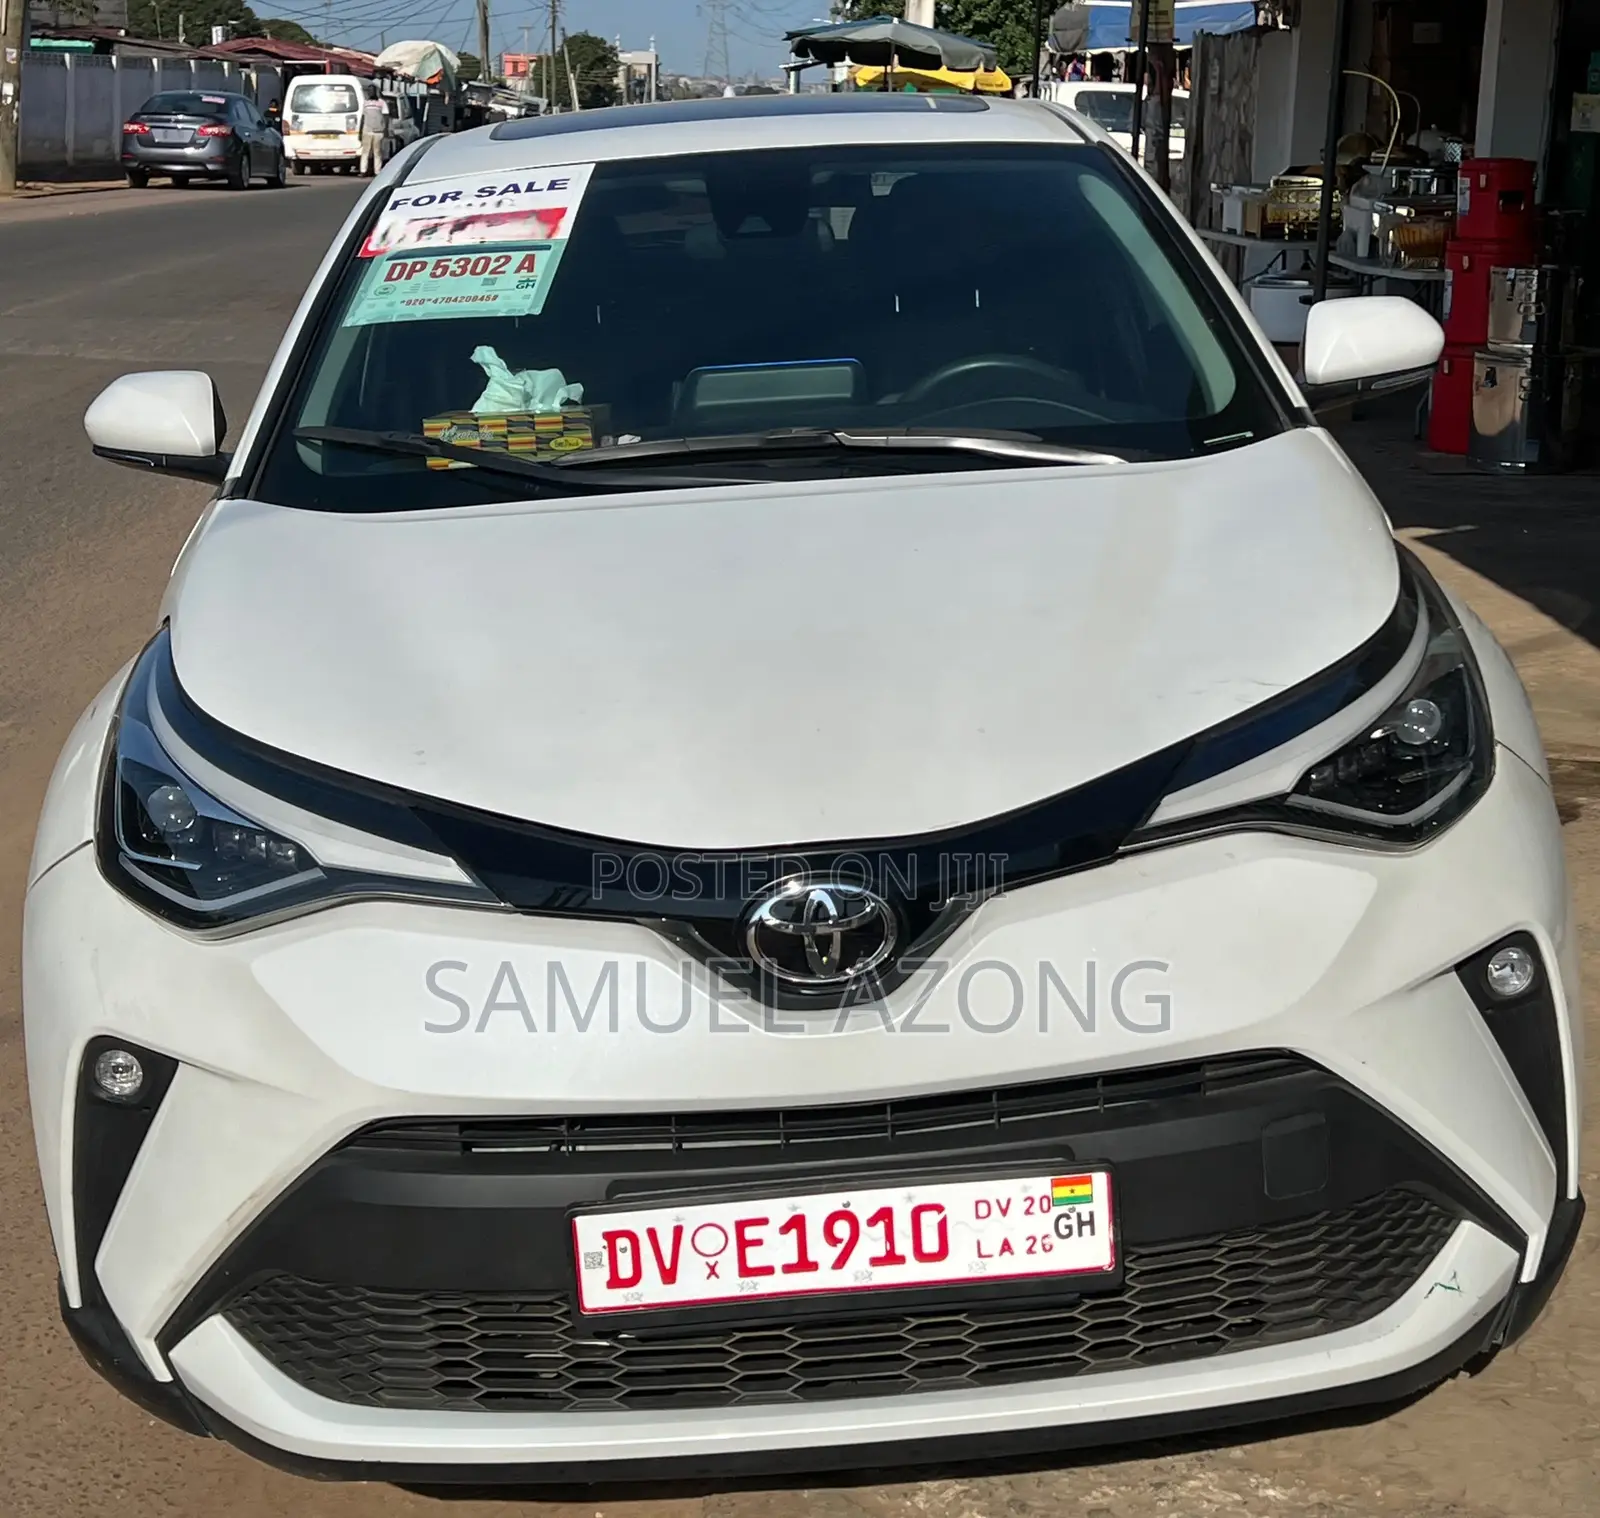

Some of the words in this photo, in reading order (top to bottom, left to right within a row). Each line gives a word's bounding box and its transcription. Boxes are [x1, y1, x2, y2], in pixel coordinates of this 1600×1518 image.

[389, 190, 463, 212] FOR
[474, 178, 571, 198] SALE
[384, 261, 428, 282] DP
[429, 254, 512, 279] 5302
[514, 253, 536, 275] A
[515, 282, 535, 290] GH
[974, 1198, 1012, 1220] DV
[1023, 1194, 1052, 1216] 20
[1053, 1211, 1096, 1240] GH
[602, 1224, 684, 1290] DV
[734, 1202, 950, 1279] E1910
[976, 1236, 1015, 1259] LA
